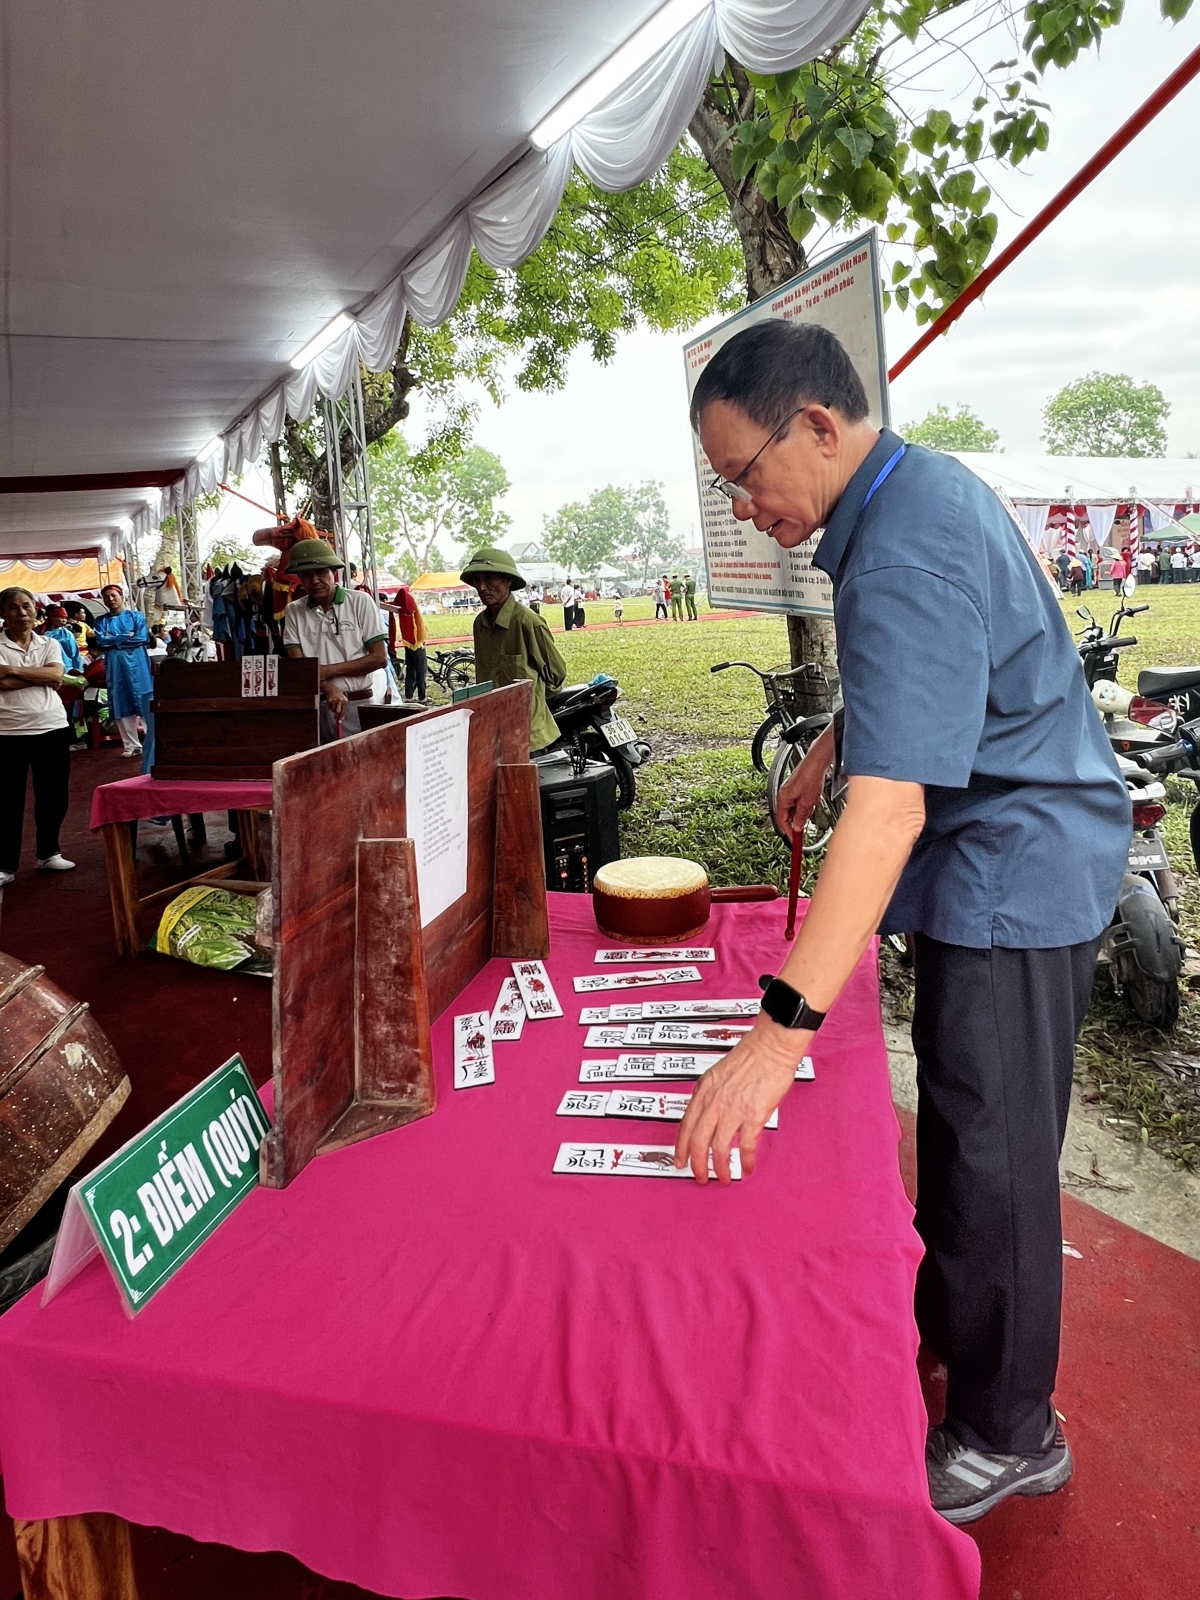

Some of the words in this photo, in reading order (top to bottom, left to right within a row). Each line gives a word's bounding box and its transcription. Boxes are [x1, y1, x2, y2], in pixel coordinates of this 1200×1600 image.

[811, 276, 822, 289] Chủ
[822, 267, 839, 283] Nghĩa
[840, 259, 852, 272] Việt
[853, 251, 868, 266] Nam
[824, 284, 838, 298] Hạnh
[110, 1209, 154, 1277] 2:
[137, 1140, 215, 1247] ĐIẾM
